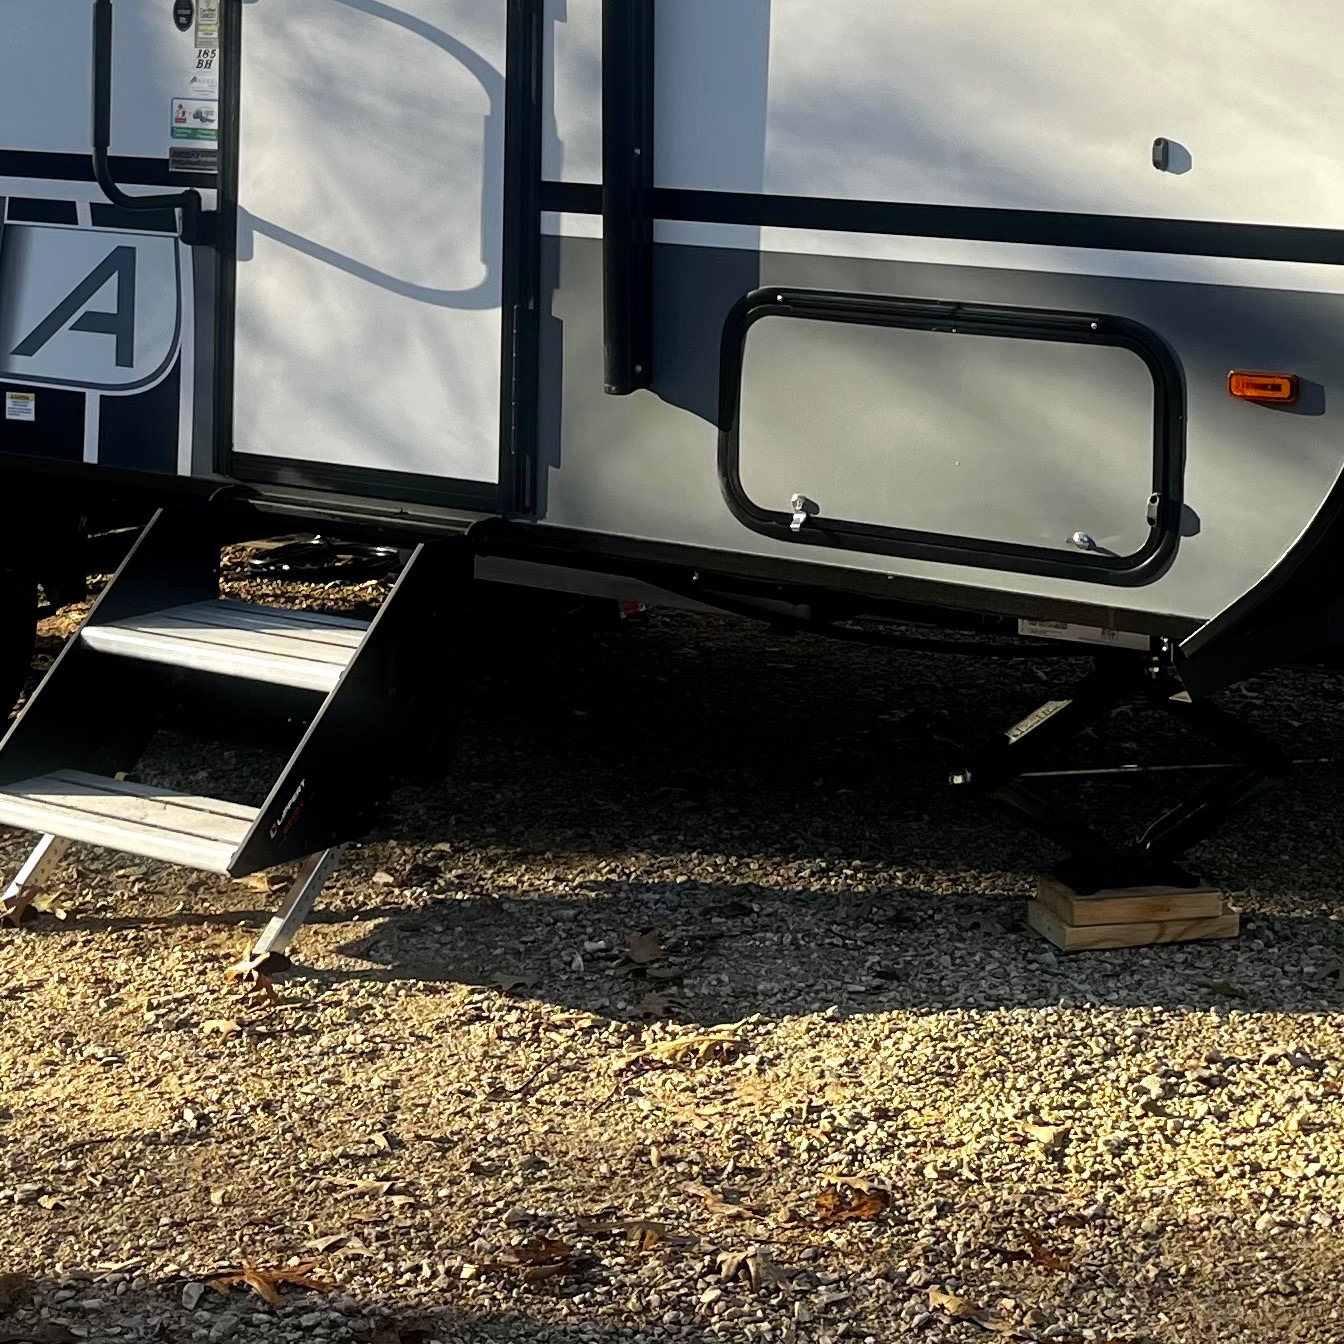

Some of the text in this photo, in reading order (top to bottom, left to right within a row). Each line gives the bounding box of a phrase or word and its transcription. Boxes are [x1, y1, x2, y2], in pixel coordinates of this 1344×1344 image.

[196, 49, 217, 59] 185
[196, 59, 213, 69] BH
[10, 245, 137, 369] A
